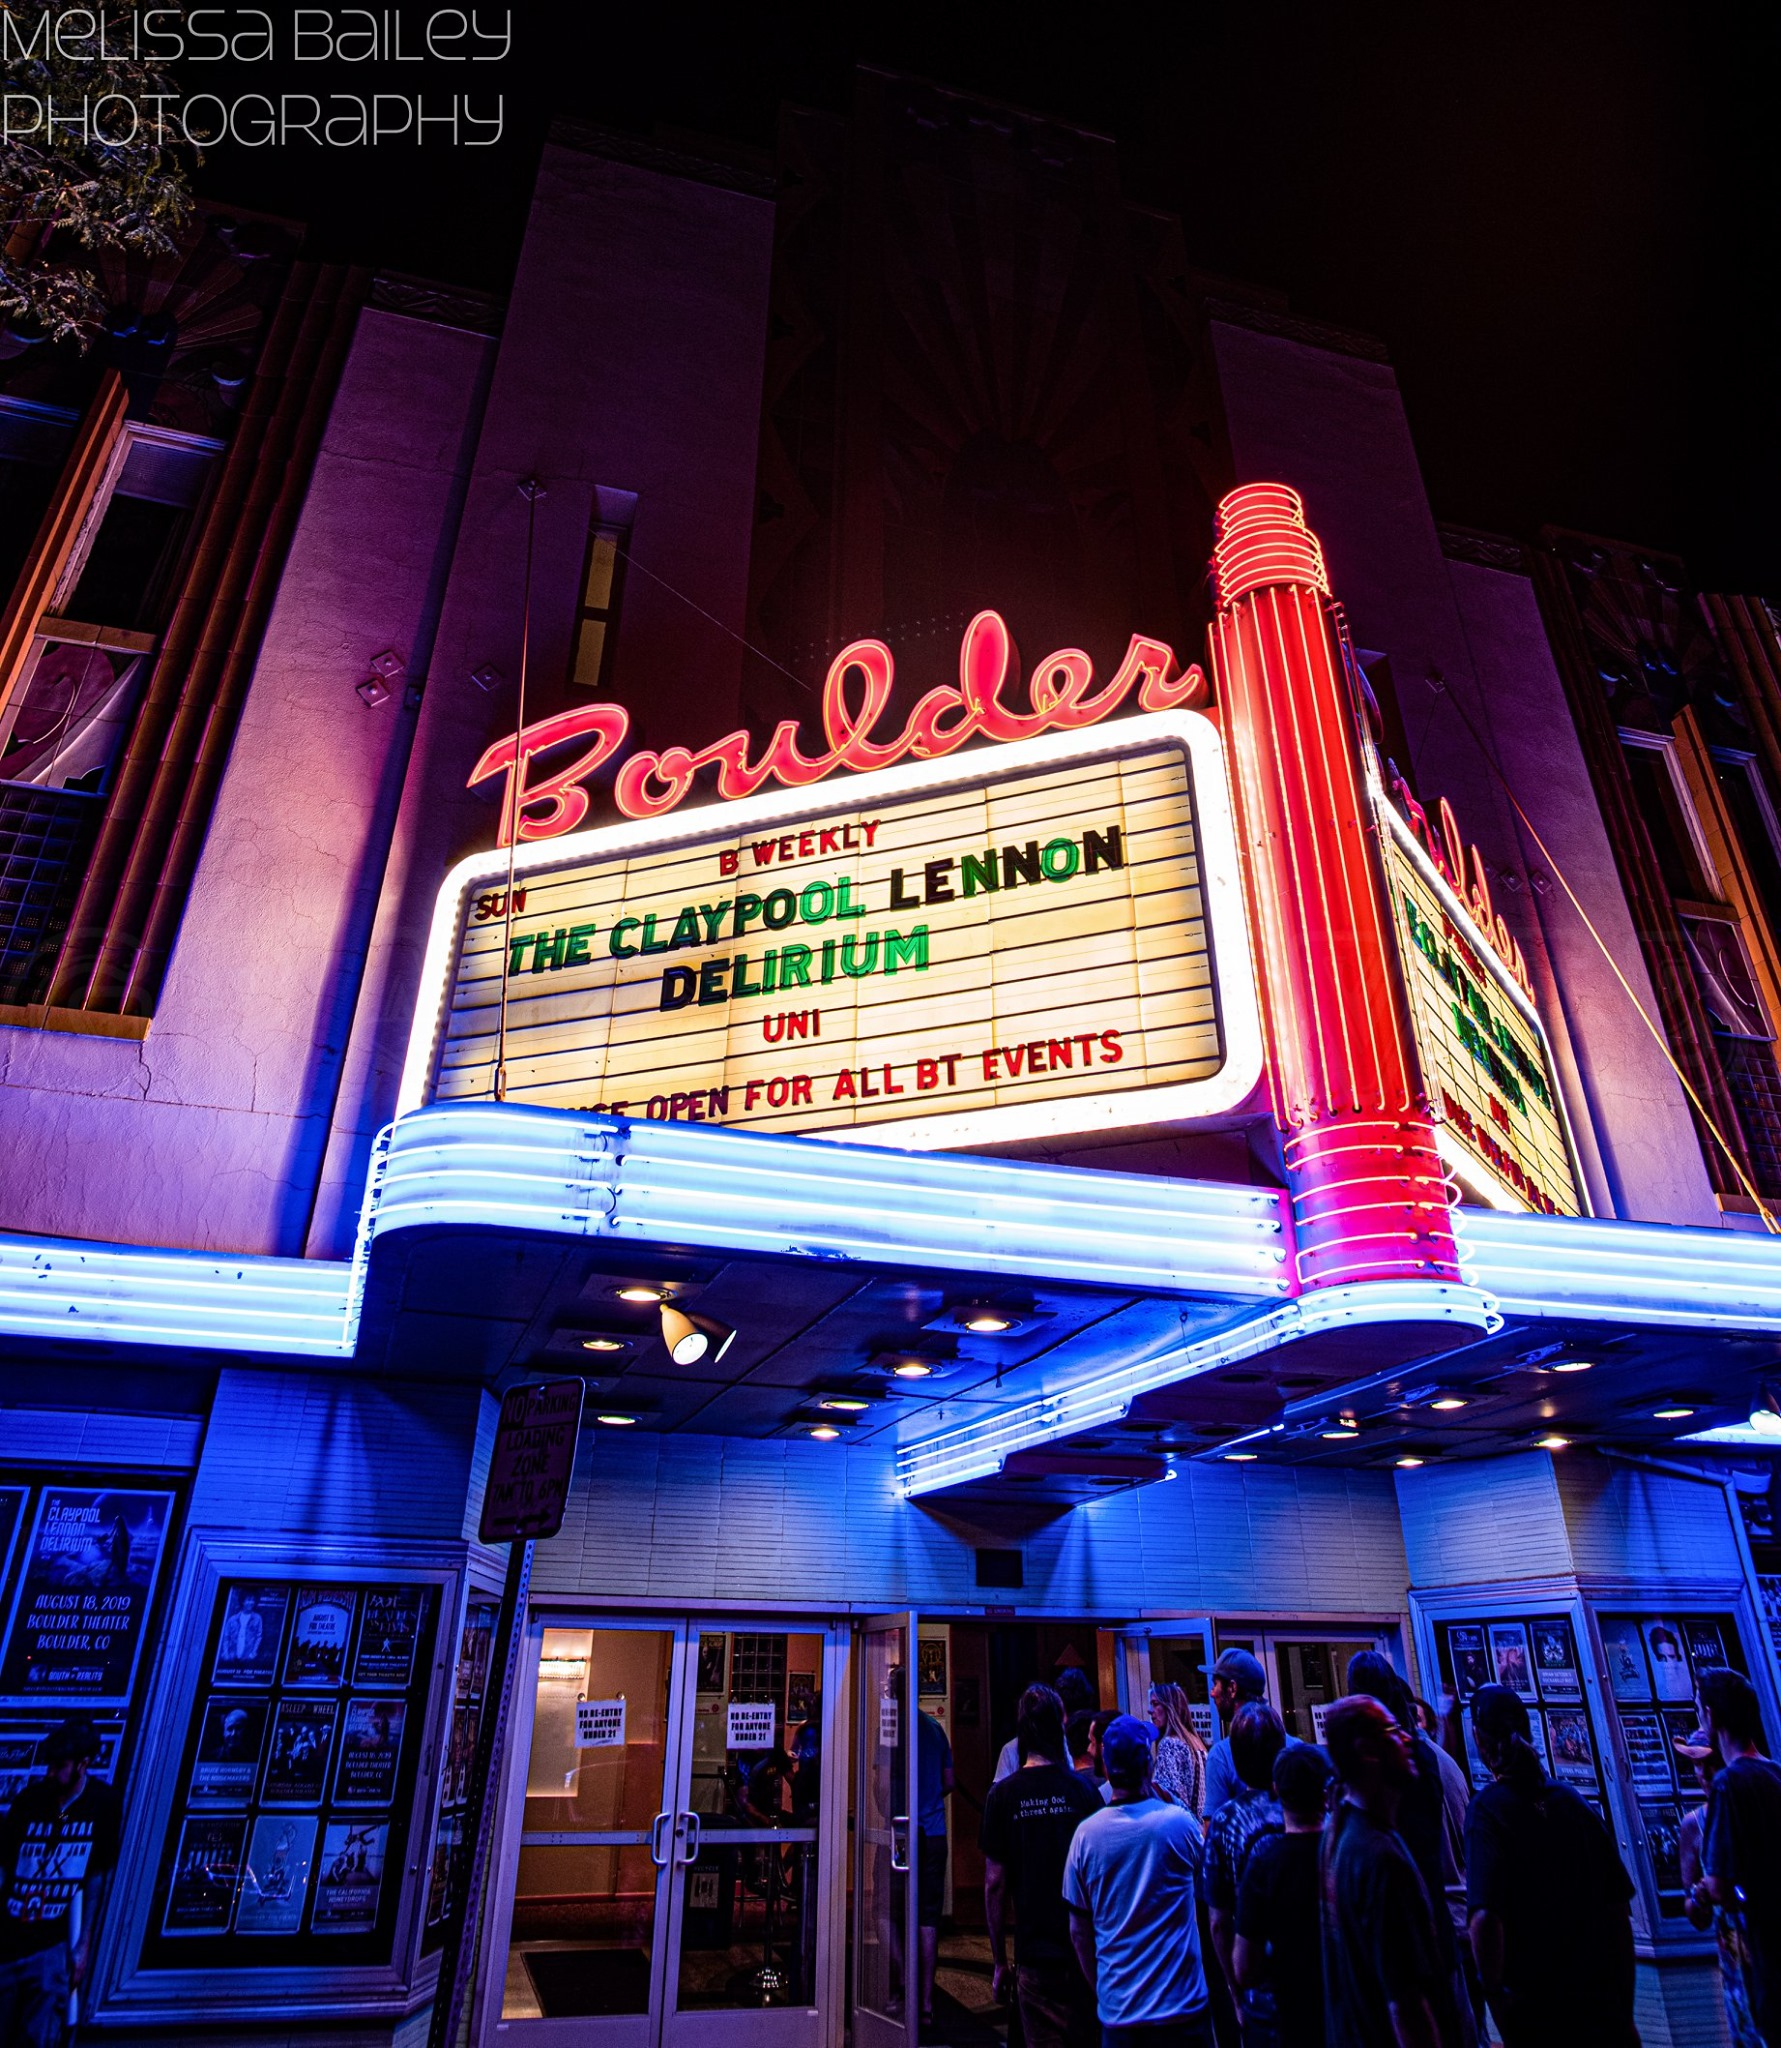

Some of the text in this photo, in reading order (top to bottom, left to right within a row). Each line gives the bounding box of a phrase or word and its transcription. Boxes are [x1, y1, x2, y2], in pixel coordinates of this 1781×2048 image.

[467, 609, 1204, 845] Boulder
[718, 818, 881, 877] B WEEKLY
[474, 886, 527, 921] SUN
[508, 825, 1125, 977] THE CLAYPOOL LENNON
[659, 923, 930, 1013] DELIRIUM
[762, 1008, 821, 1043] UNI
[646, 1085, 729, 1122] OPEN
[744, 1074, 814, 1110] FOR
[832, 1061, 904, 1099] ALL
[917, 1053, 963, 1091] BT
[981, 1029, 1123, 1079] EVENTS
[526, 1393, 577, 1416] PARKING
[506, 1428, 563, 1451] LOADING
[512, 1455, 549, 1477] ZONE
[47, 1506, 101, 1524] CLAYPOOL
[35, 1593, 132, 1612] AUGUST 18, 2019
[26, 1613, 131, 1631] BOULDER THEATER
[36, 1633, 111, 1651] BOULDER, CO
[313, 1704, 335, 1716] WHEEL
[578, 1708, 622, 1718] NO RE-ENTRY
[730, 1711, 772, 1721] NO RE-ENTRY
[579, 1718, 621, 1729] FOR ANYONE
[731, 1722, 770, 1731] FOR ANYONE
[583, 1729, 616, 1740] UNDER 21
[735, 1732, 766, 1741] UNDER 21
[1020, 1798, 1049, 1808] Making
[1020, 1807, 1047, 1818] threat
